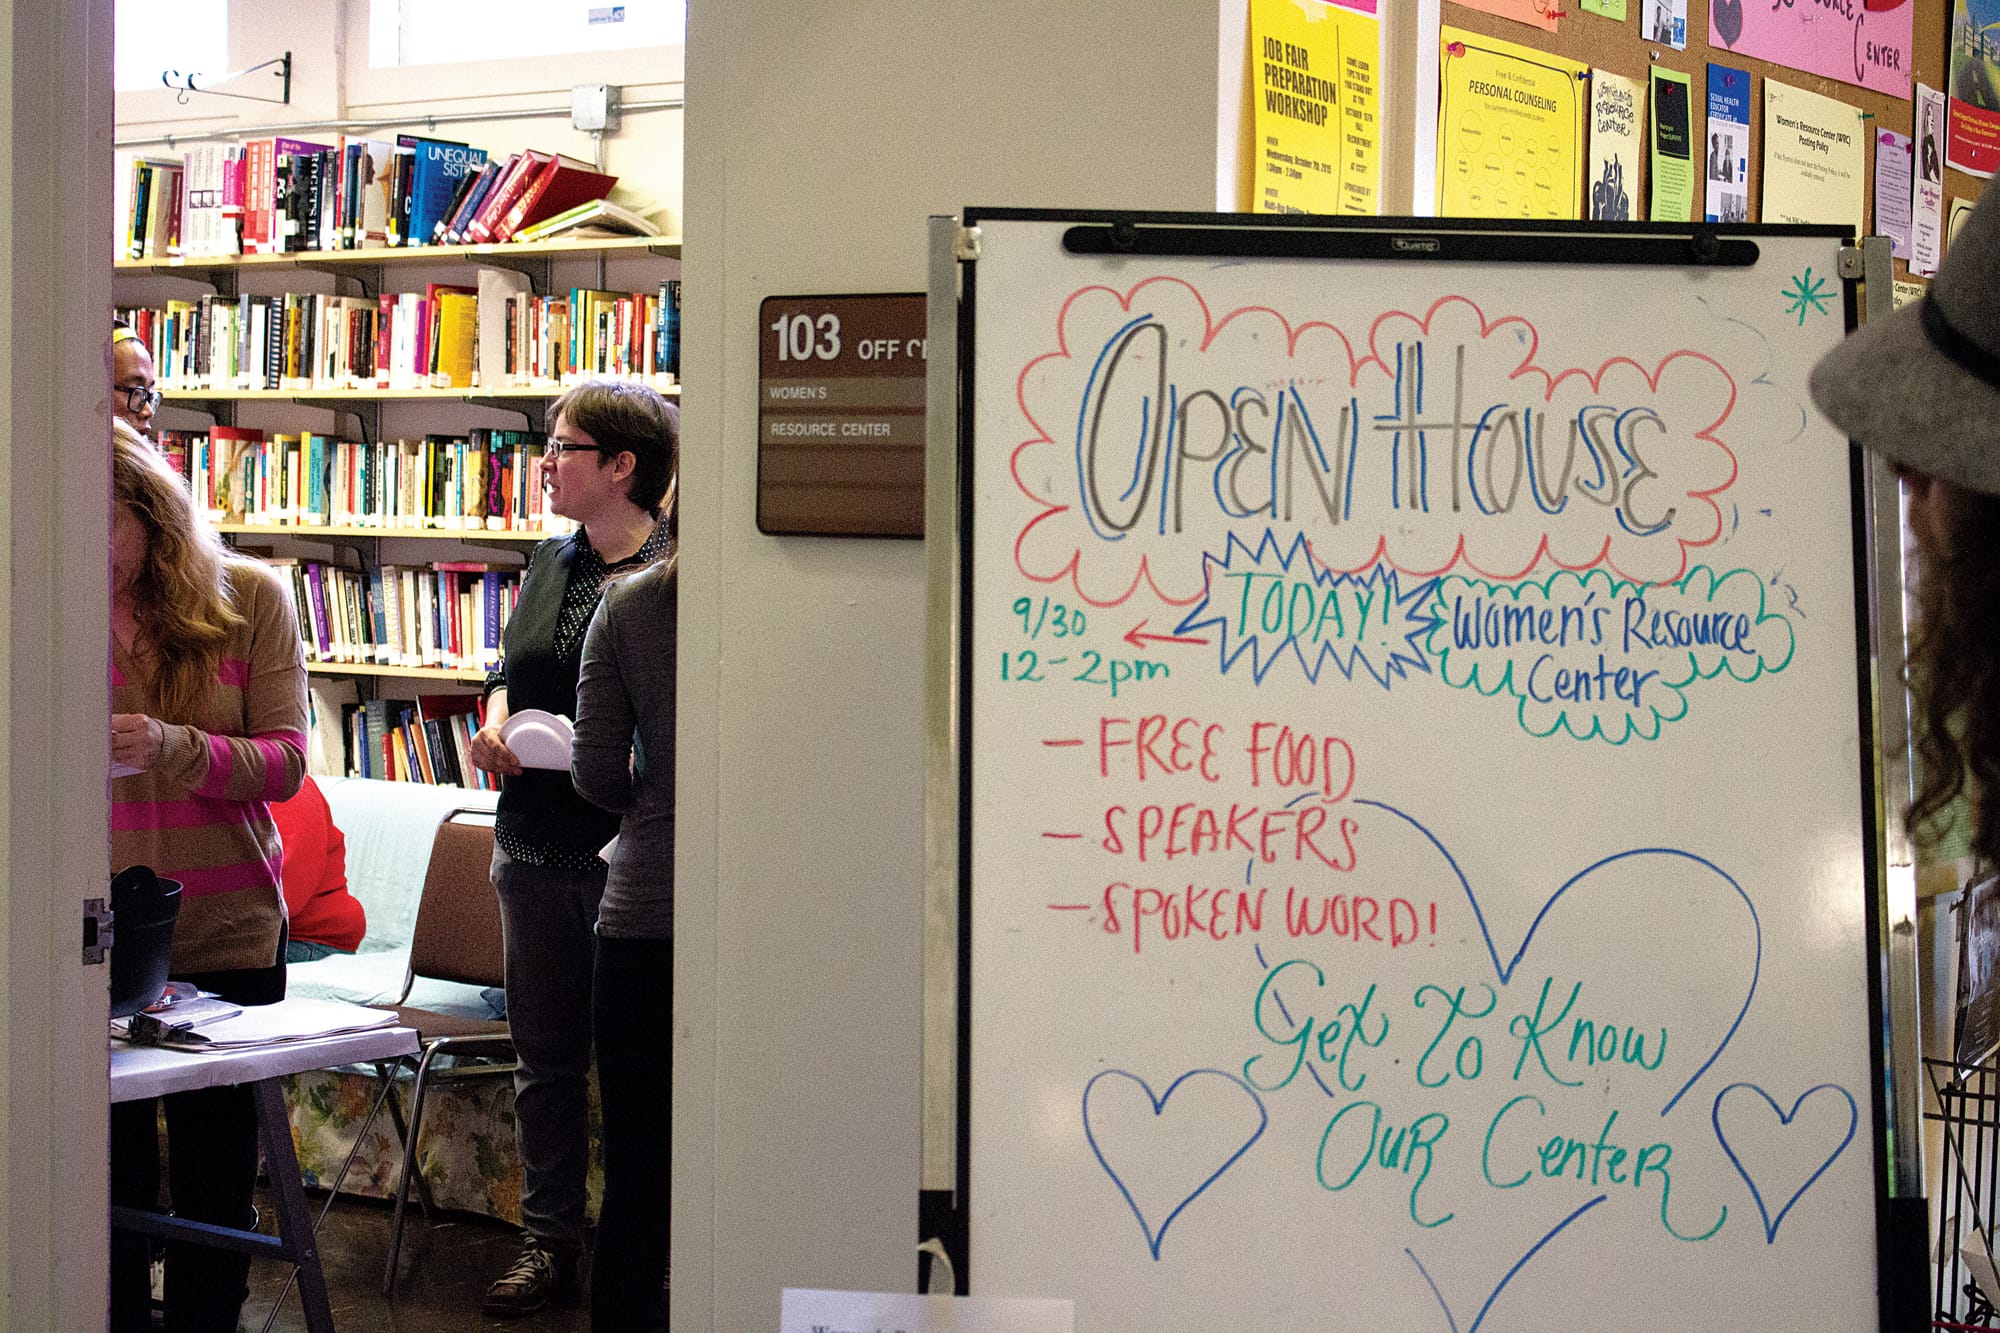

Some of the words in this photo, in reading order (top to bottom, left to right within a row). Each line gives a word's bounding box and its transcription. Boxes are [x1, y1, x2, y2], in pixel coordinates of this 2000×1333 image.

[1264, 36, 1282, 62] JOB
[1285, 42, 1309, 71] FAIR
[1854, 13, 1900, 82] CENTER
[1264, 62, 1336, 105] PREPARATION
[1496, 70, 1506, 80] Free
[1265, 89, 1328, 128] WORKSHOP
[1469, 80, 1513, 101] PERSONAL
[1514, 90, 1557, 113] COUNSELING
[1724, 96, 1740, 107] HEALTH
[1776, 115, 1798, 130] Women's
[1800, 122, 1820, 136] Resource
[1820, 127, 1836, 140] Center
[1836, 132, 1851, 147] (WRC)
[1798, 135, 1816, 151] Posting
[1816, 139, 1829, 154] Policy
[428, 146, 482, 165] UNEQUAL
[277, 178, 286, 199] PCs
[1895, 283, 1908, 294] Center
[771, 313, 842, 361] 103
[858, 339, 900, 360] OFF
[770, 386, 827, 399] WOMEN'S
[771, 423, 836, 437] RESOURCE
[842, 423, 890, 437] CENTER
[1012, 596, 1088, 640] 9/30
[1224, 572, 1392, 647] TODAY!
[1454, 591, 1611, 650] Women's
[1624, 597, 1756, 655] Resource
[489, 618, 497, 645] FIRE
[1528, 654, 1660, 708] Center
[1100, 714, 1225, 783] FREE
[1246, 722, 1356, 804] FOOD
[1102, 802, 1359, 873] SPEAKERS
[1104, 882, 1268, 954] SPOKEN
[1286, 886, 1438, 949] WORD!
[1243, 958, 1389, 1092] Get
[1414, 982, 1498, 1088] To
[1509, 976, 1668, 1087] Know
